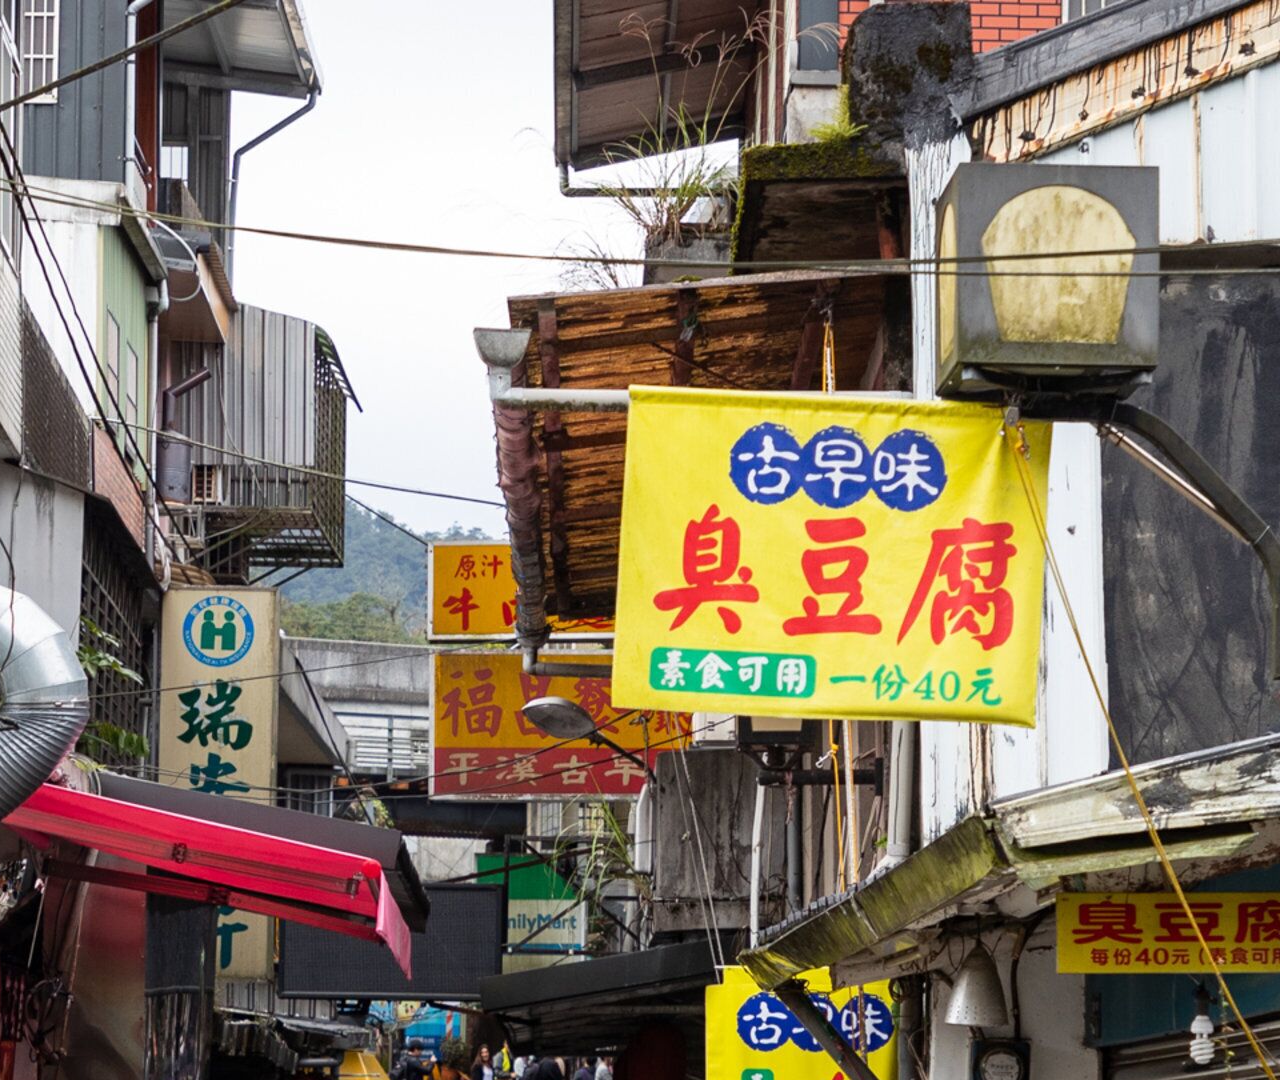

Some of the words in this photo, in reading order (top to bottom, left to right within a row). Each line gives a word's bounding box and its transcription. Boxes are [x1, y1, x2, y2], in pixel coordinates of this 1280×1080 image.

[737, 433, 940, 502] 古早味
[454, 554, 503, 581] 原汁
[653, 503, 1018, 651] 臭豆腐
[442, 586, 518, 632] 牛
[657, 649, 808, 695] 素食可用
[829, 662, 1002, 706] 一份40元
